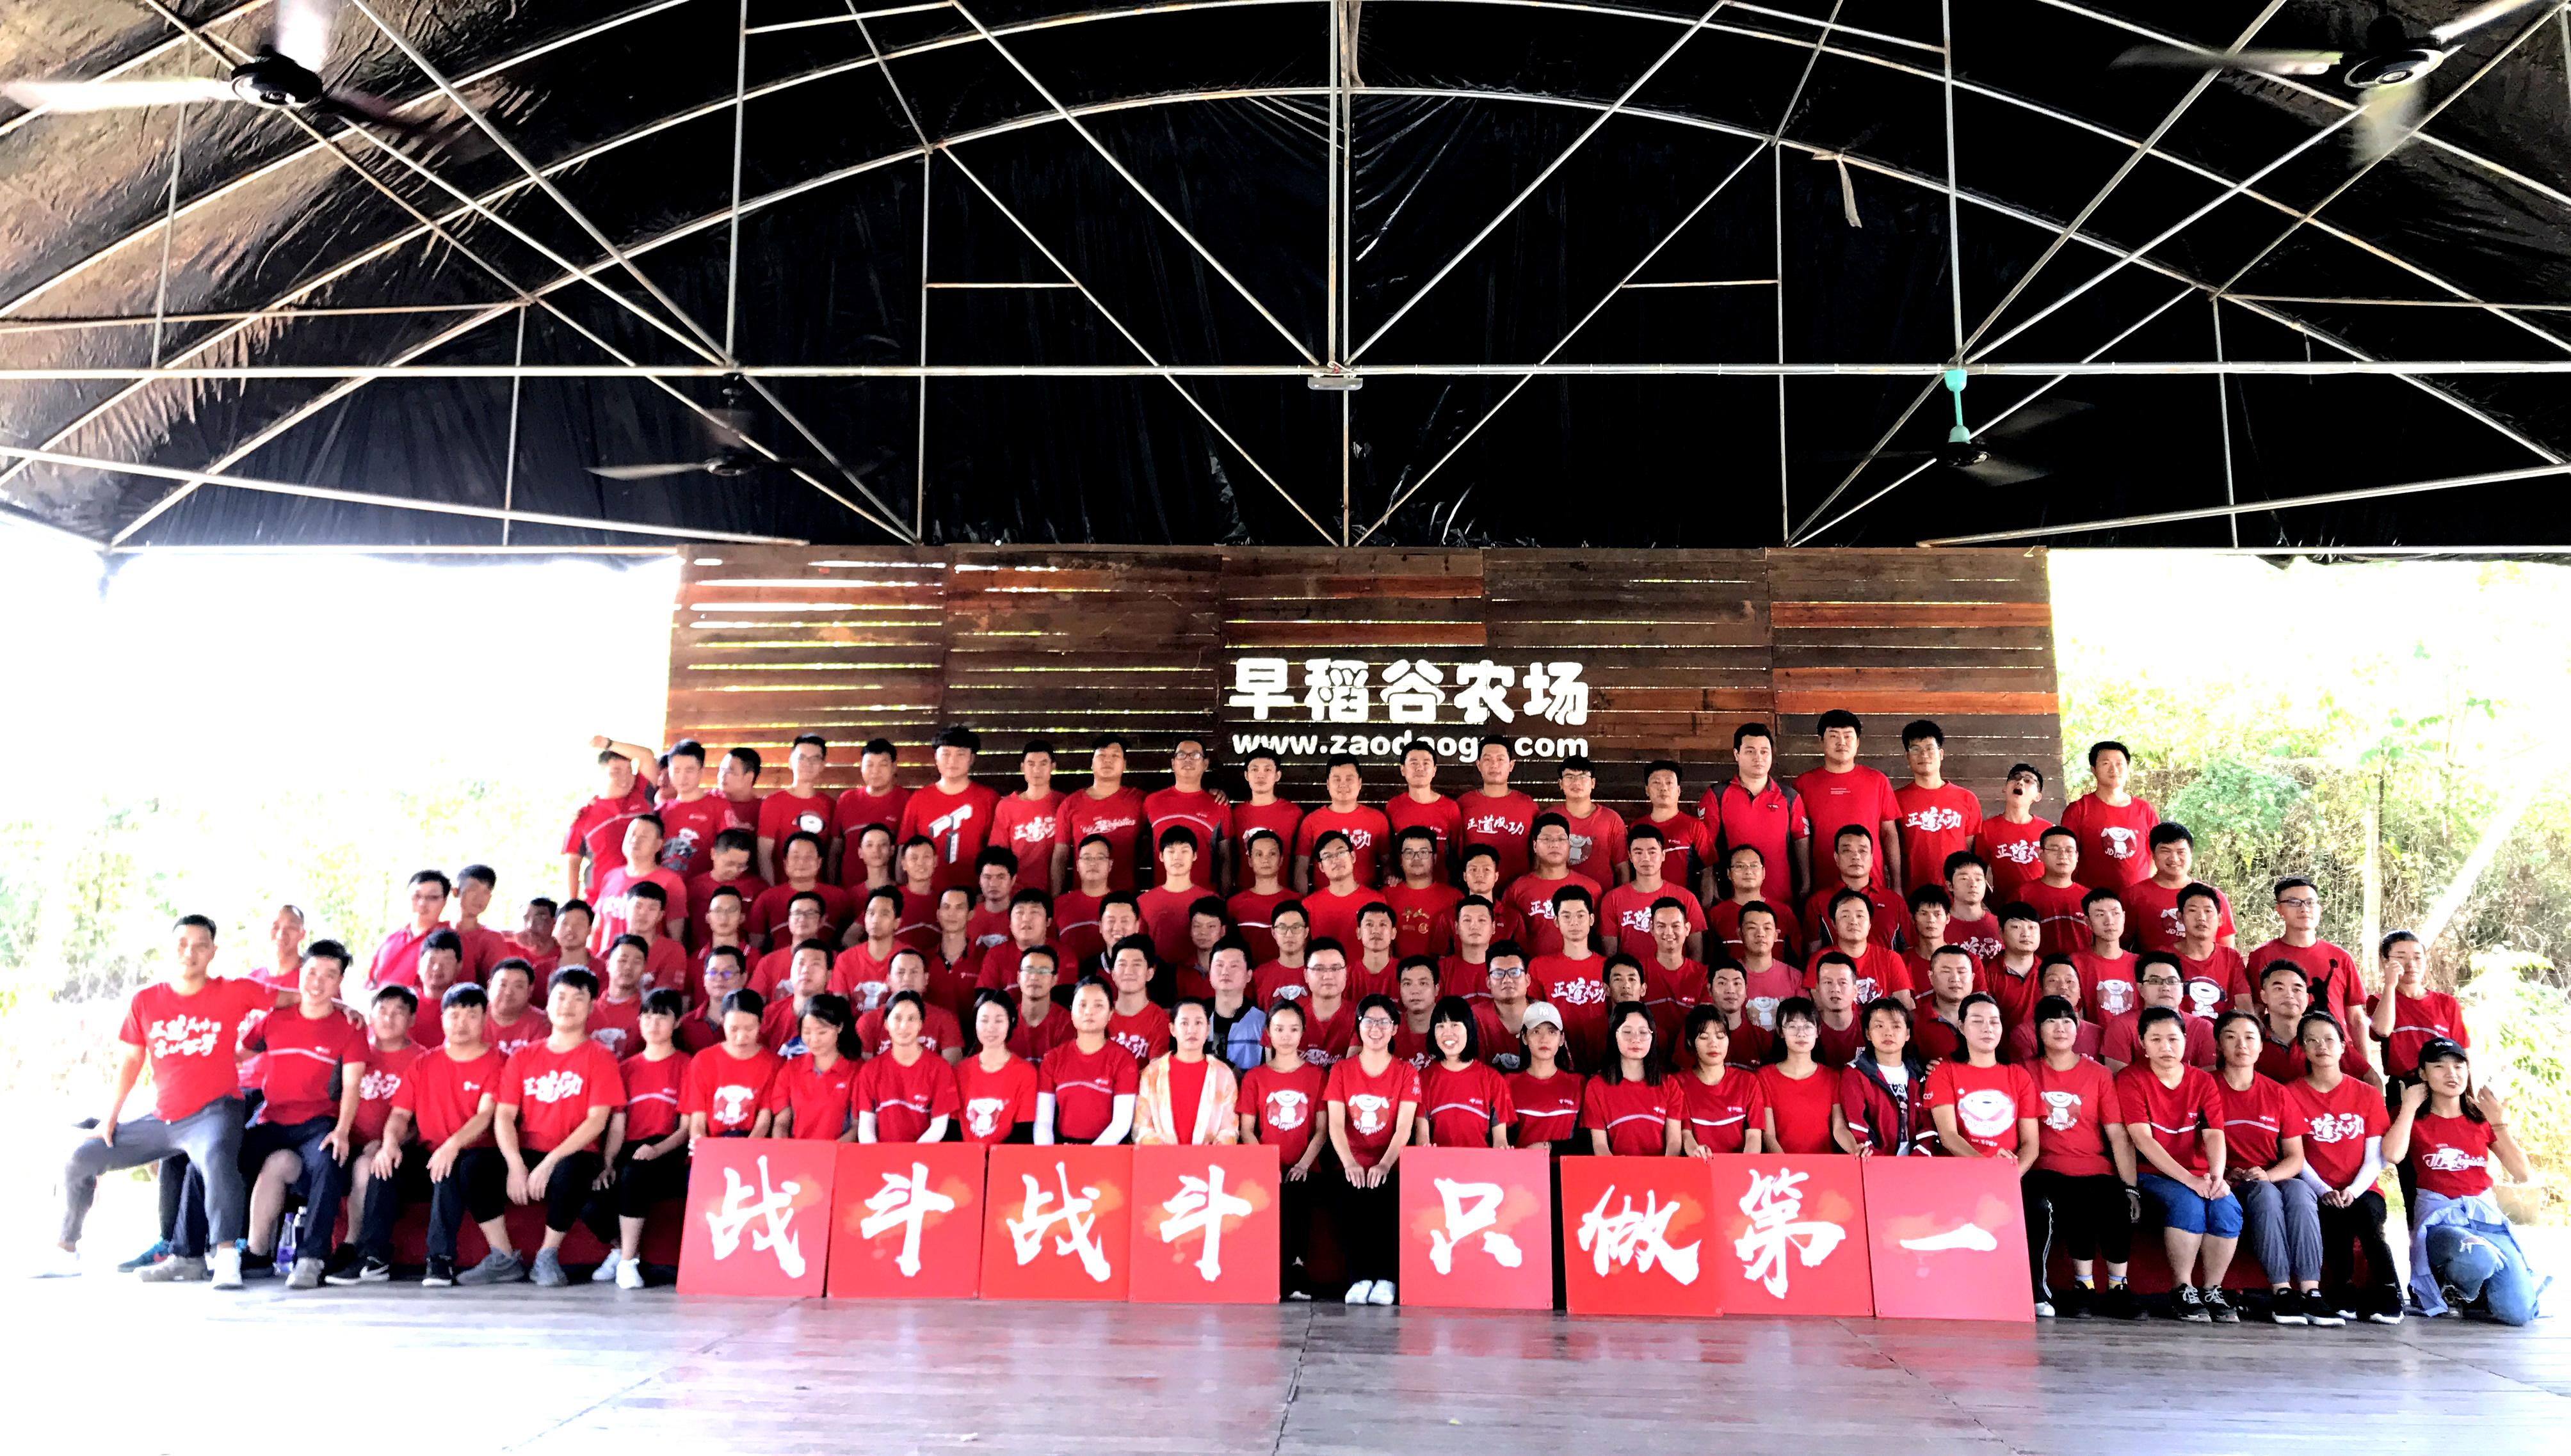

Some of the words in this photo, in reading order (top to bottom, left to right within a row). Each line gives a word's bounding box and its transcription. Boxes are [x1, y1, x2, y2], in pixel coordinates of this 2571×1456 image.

[1229, 658, 1588, 725] 早稻谷农场
[1232, 730, 1588, 763] www.zaodogcom
[1467, 815, 1524, 835] 正道成功
[705, 1155, 1253, 1283] 战斗战斗
